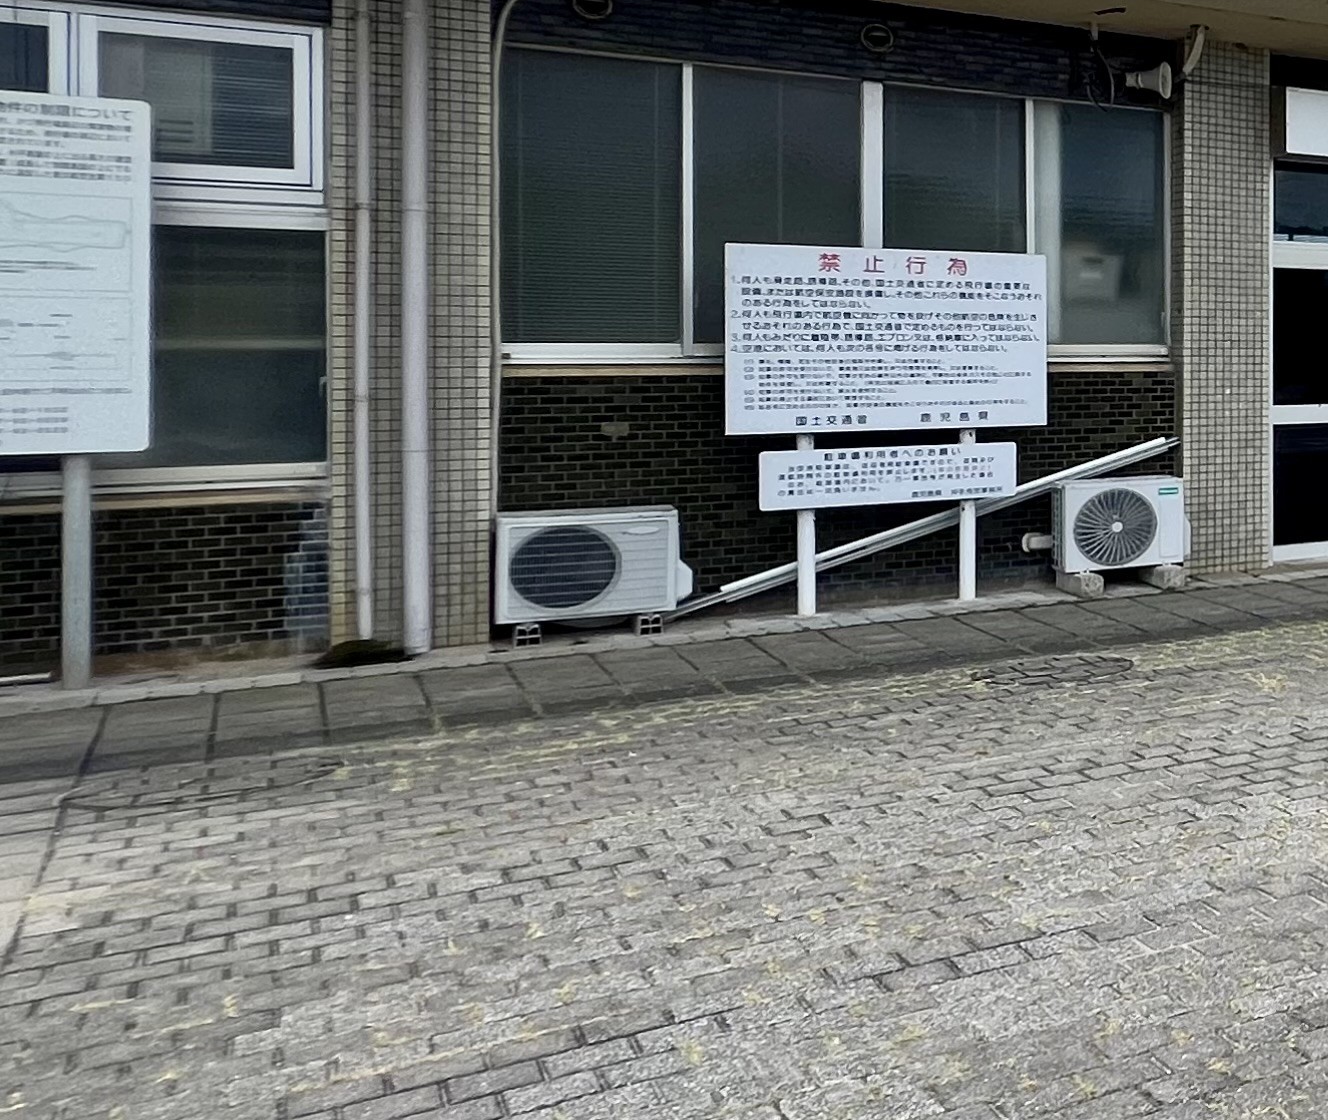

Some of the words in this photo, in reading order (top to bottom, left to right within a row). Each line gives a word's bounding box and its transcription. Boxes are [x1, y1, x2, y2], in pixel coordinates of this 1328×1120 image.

[818, 252, 968, 276] 禁止行為
[795, 414, 868, 427] 国土交通省
